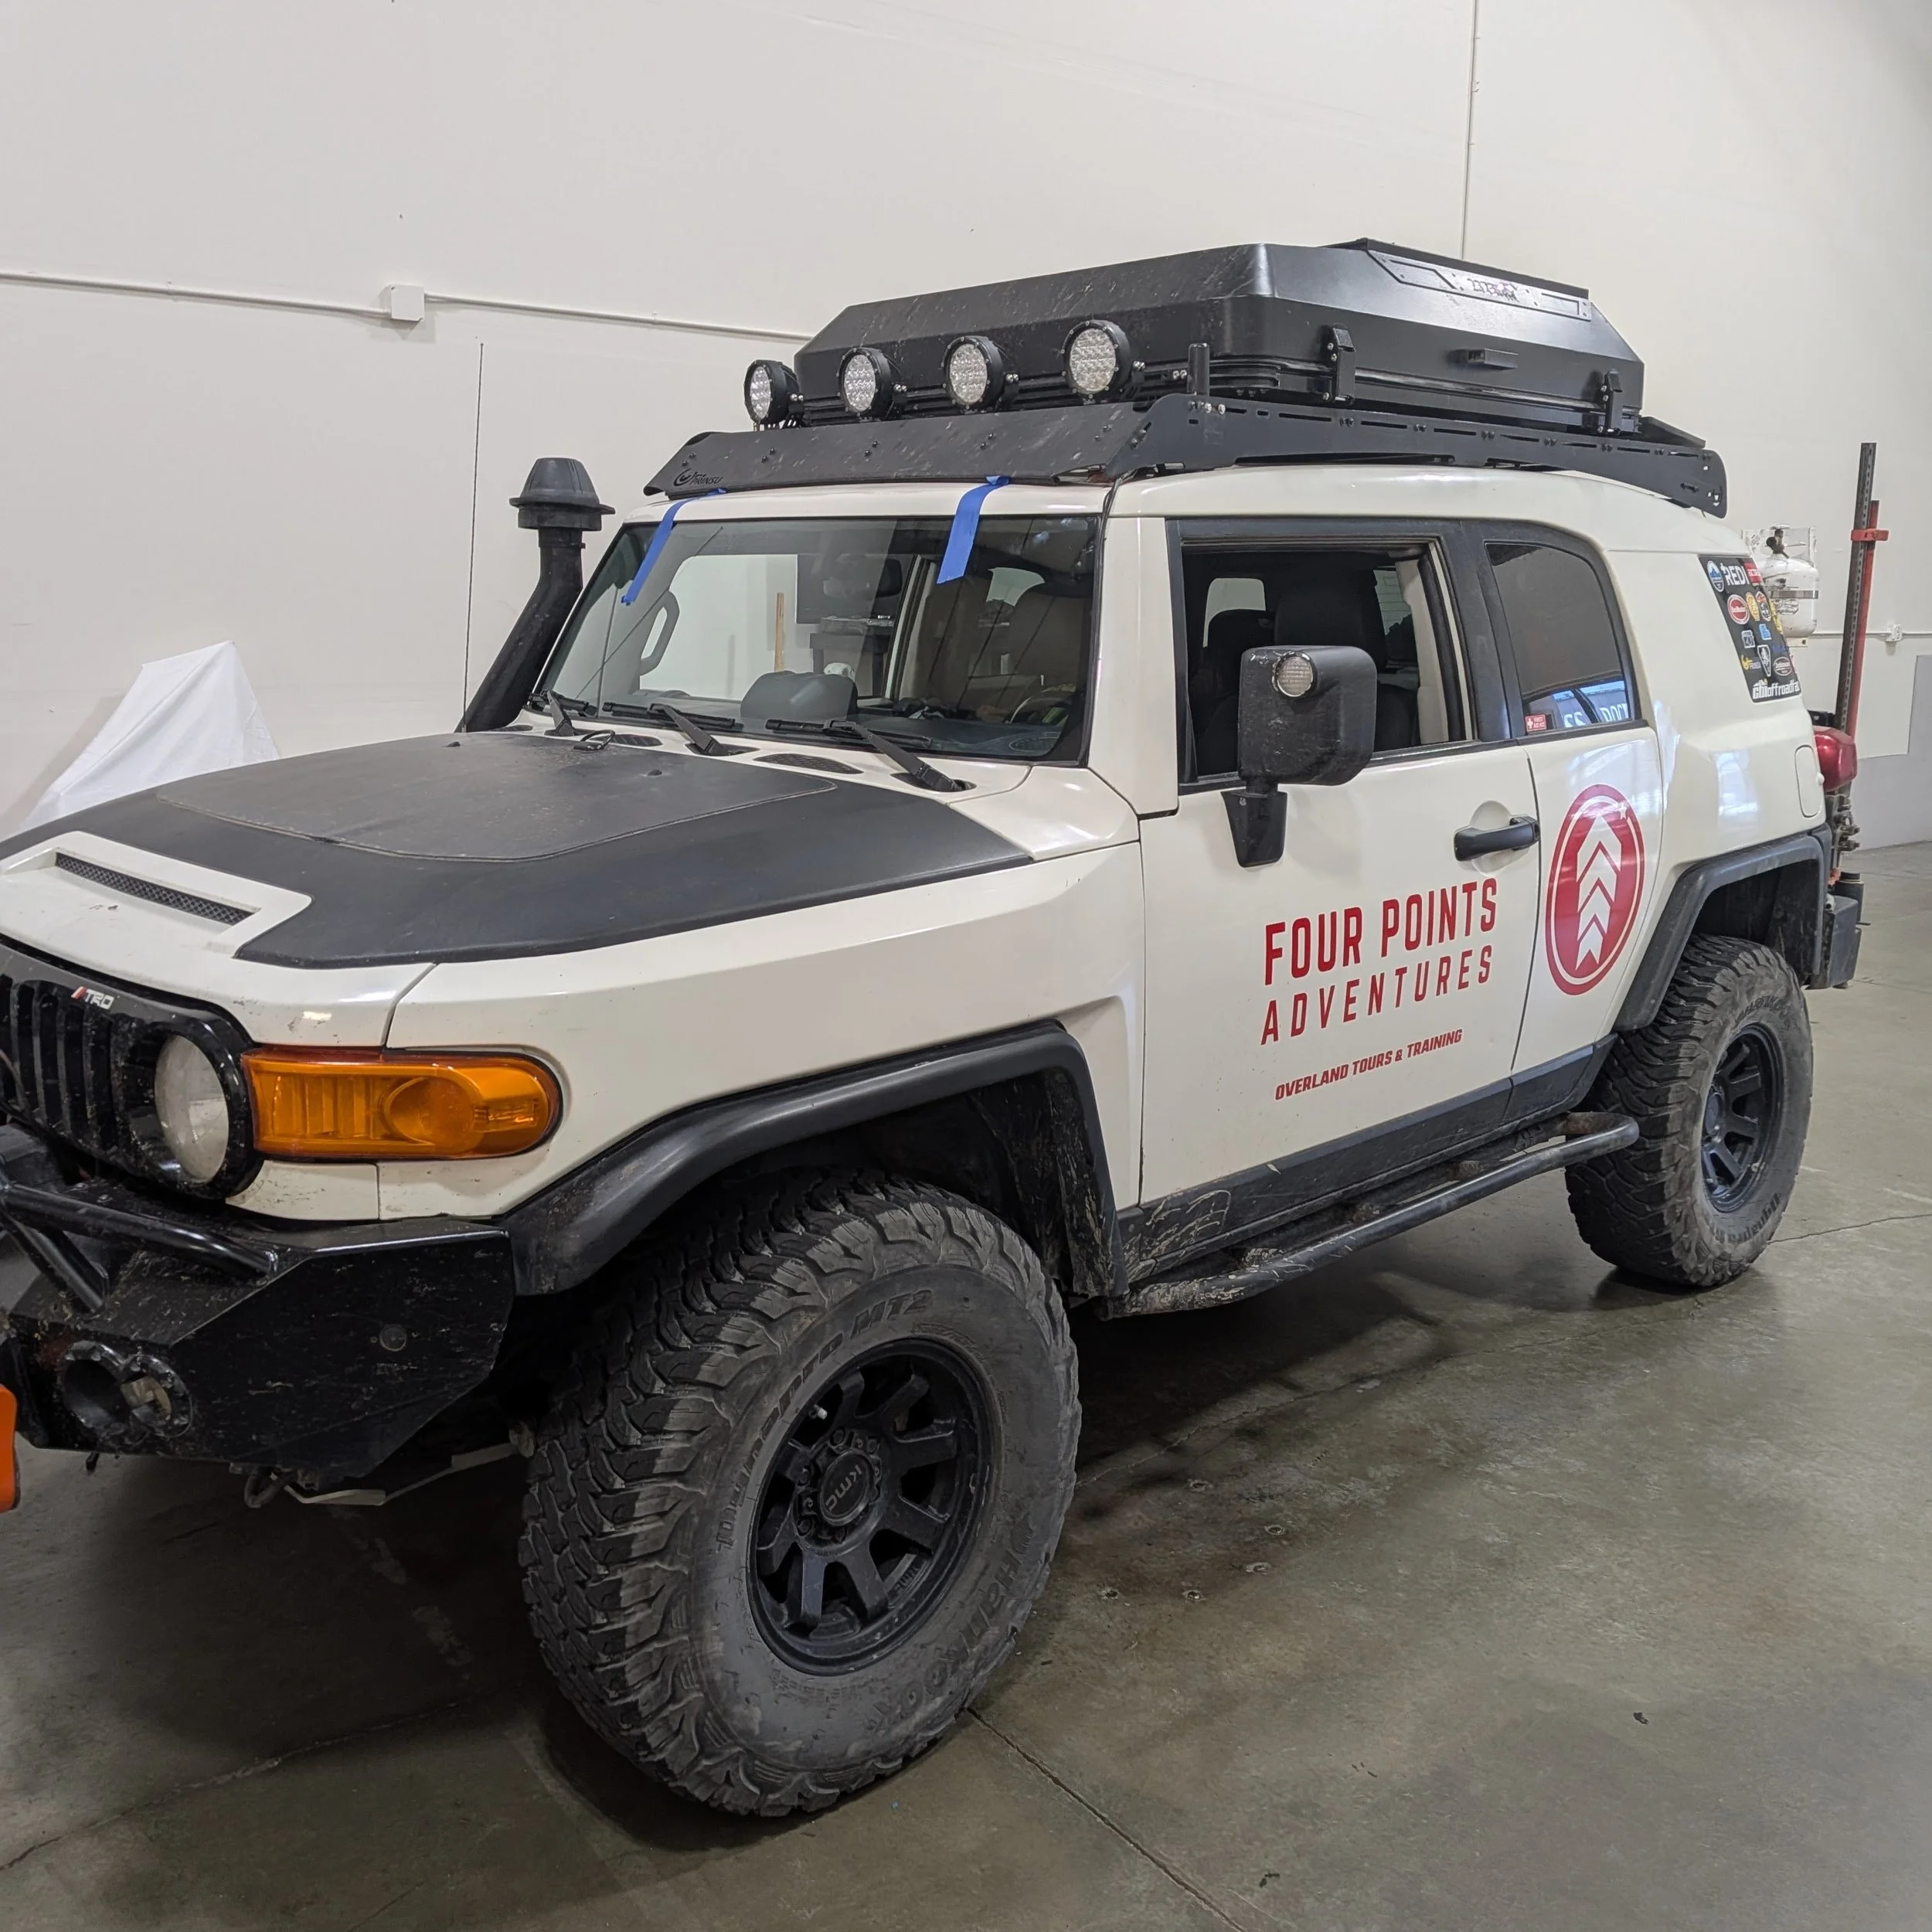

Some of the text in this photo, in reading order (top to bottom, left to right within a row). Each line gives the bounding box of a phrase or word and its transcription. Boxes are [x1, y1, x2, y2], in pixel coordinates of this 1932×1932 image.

[1264, 878, 1498, 986] FOUR POINTS
[85, 989, 114, 1009] TRD
[1260, 945, 1493, 1046] ADVENTURES
[1274, 1029, 1463, 1101] OVERLAND TOURS & TRAINING
[849, 1289, 934, 1338] MT2
